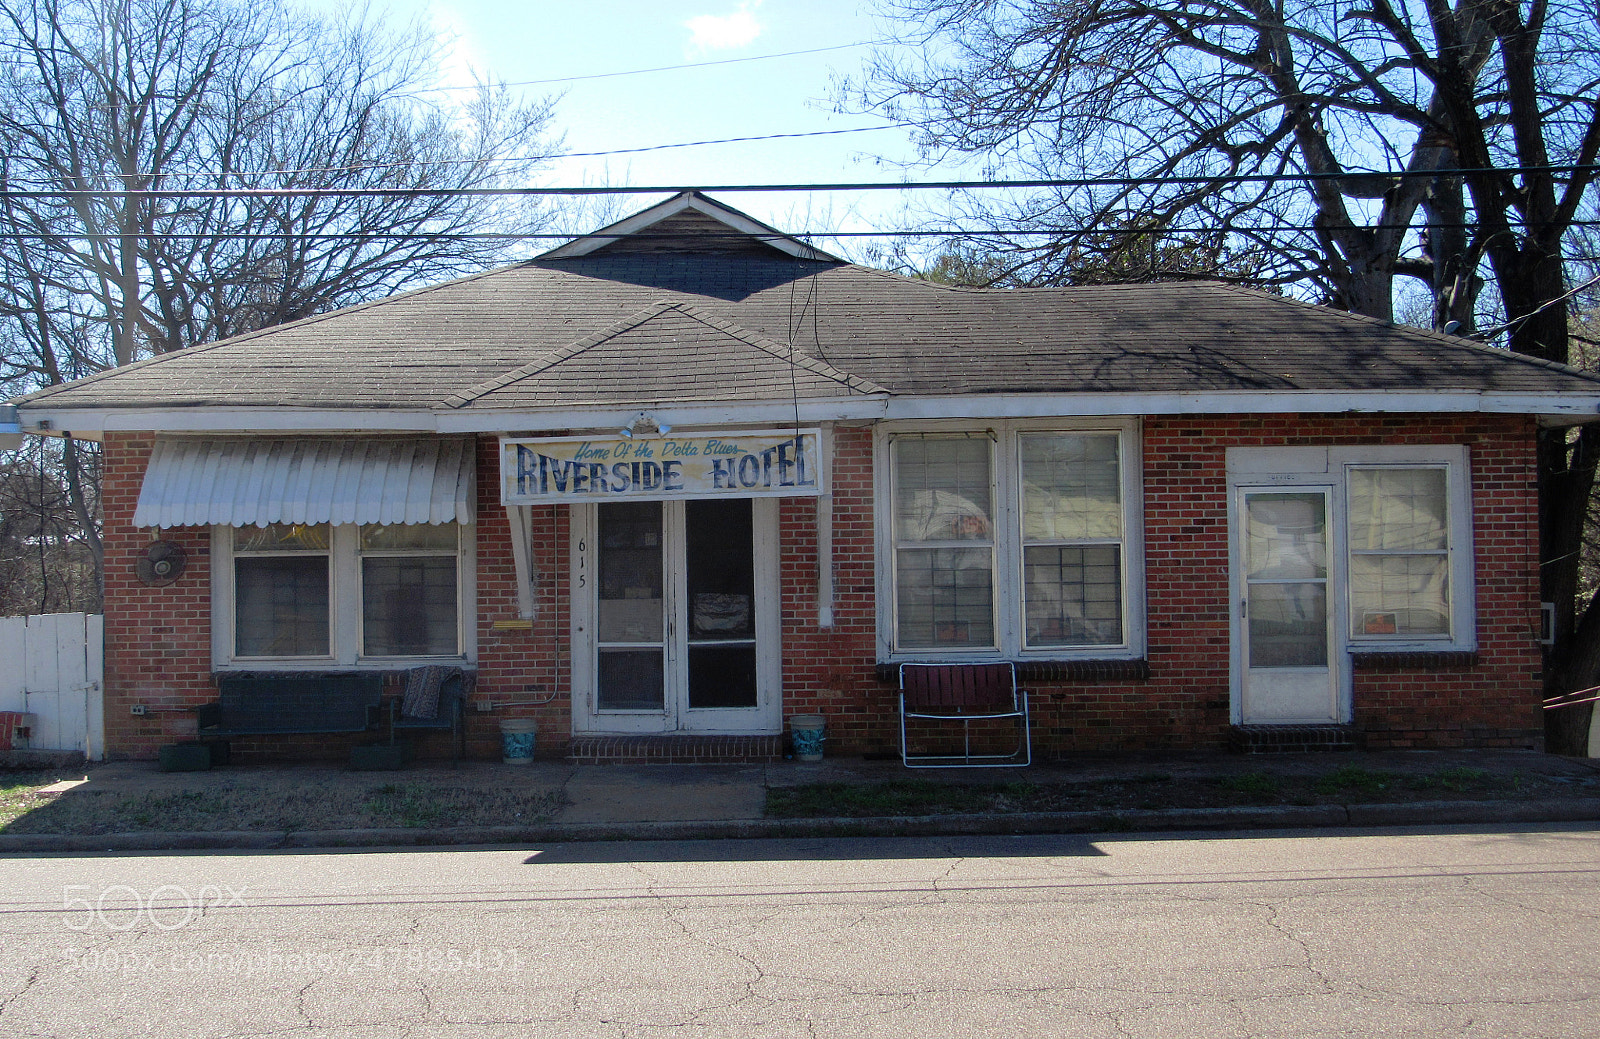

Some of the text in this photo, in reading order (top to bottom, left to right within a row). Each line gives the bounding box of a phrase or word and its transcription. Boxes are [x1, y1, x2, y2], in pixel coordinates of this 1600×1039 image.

[516, 434, 815, 495] RIVERSIDE HOTEL
[575, 440, 748, 461] Home Of the Delta Blues
[578, 537, 586, 588] 615
